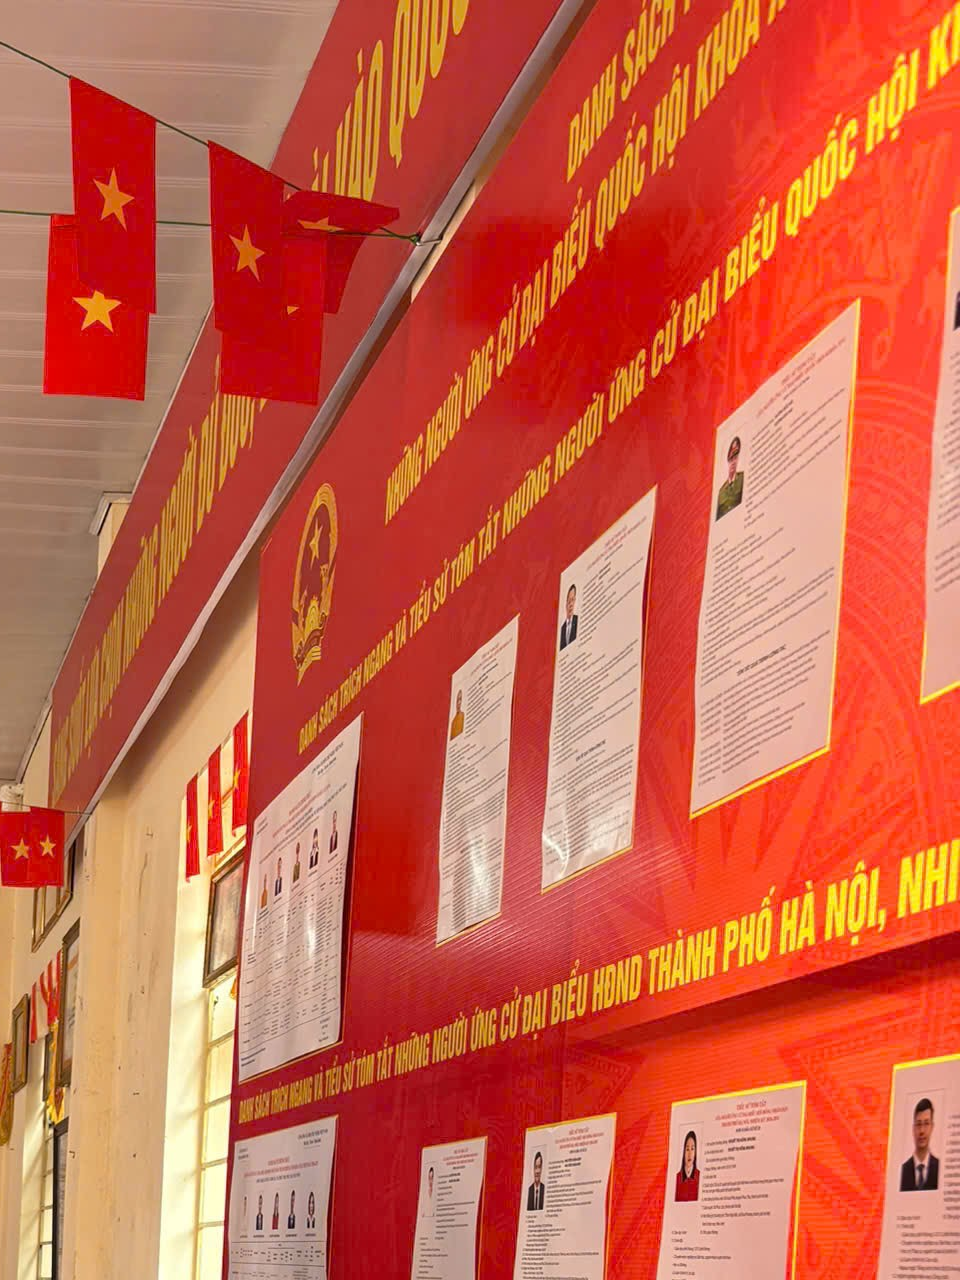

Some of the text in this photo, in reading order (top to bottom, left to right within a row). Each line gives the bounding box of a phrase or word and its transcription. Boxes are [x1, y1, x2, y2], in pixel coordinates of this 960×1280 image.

[566, 54, 618, 183] DANH
[298, 712, 318, 755] DANH
[318, 690, 338, 733] SÁCH
[339, 663, 362, 711] TRÍCH
[363, 630, 393, 684] NGANG
[394, 608, 407, 653] VÀ
[409, 580, 430, 637] TIỂU
[432, 557, 449, 613] SỬ
[450, 543, 475, 594] TÓM
[478, 504, 501, 564] TẮT
[502, 454, 551, 540] NHỮNG
[554, 391, 604, 484] NGƯỜI
[608, 348, 647, 423] ỨNG
[651, 299, 682, 378] CỬ
[682, 266, 720, 347] ĐẠI
[724, 196, 779, 303] BIỂU
[785, 112, 858, 238] QUỐC
[865, 47, 920, 155] HỘI
[385, 433, 423, 526] NHỮNG
[424, 371, 463, 474] NGƯỜI
[464, 335, 494, 420] ỨNG
[496, 282, 520, 378] CỬ
[520, 258, 549, 350] ĐẠI
[550, 186, 592, 310] BIỂU
[594, 112, 647, 251] QUỐC
[651, 63, 690, 176] HỘI
[123, 523, 158, 674] NHỮNG
[158, 425, 197, 607] NGƯỜI
[197, 353, 219, 534] ĐỦ
[239, 838, 960, 1124] DANH SÁCH TRÍCH NGANG VÀ TIỂU SỬ TÓM TẮT NHỮNG NGƯỜI ỨNG CỬ ĐẠI BIỂU HĐND THÀNH PHỐ HÀ NỘI, NHI
